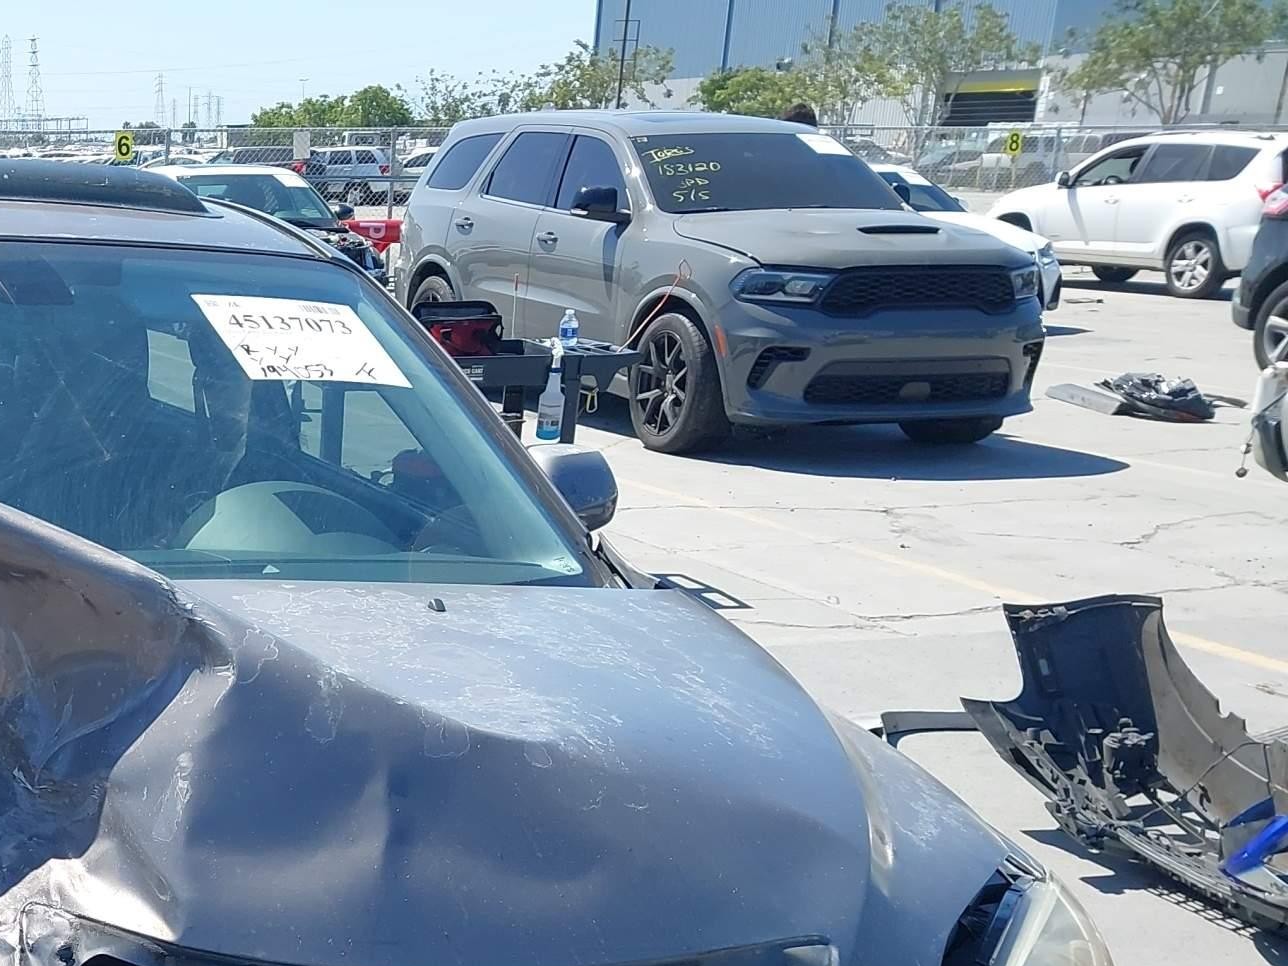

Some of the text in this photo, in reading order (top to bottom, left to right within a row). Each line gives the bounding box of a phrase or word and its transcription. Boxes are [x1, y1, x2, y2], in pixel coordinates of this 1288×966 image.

[117, 135, 130, 156] 6
[1009, 132, 1019, 152] 8
[228, 314, 352, 335] 45137073
